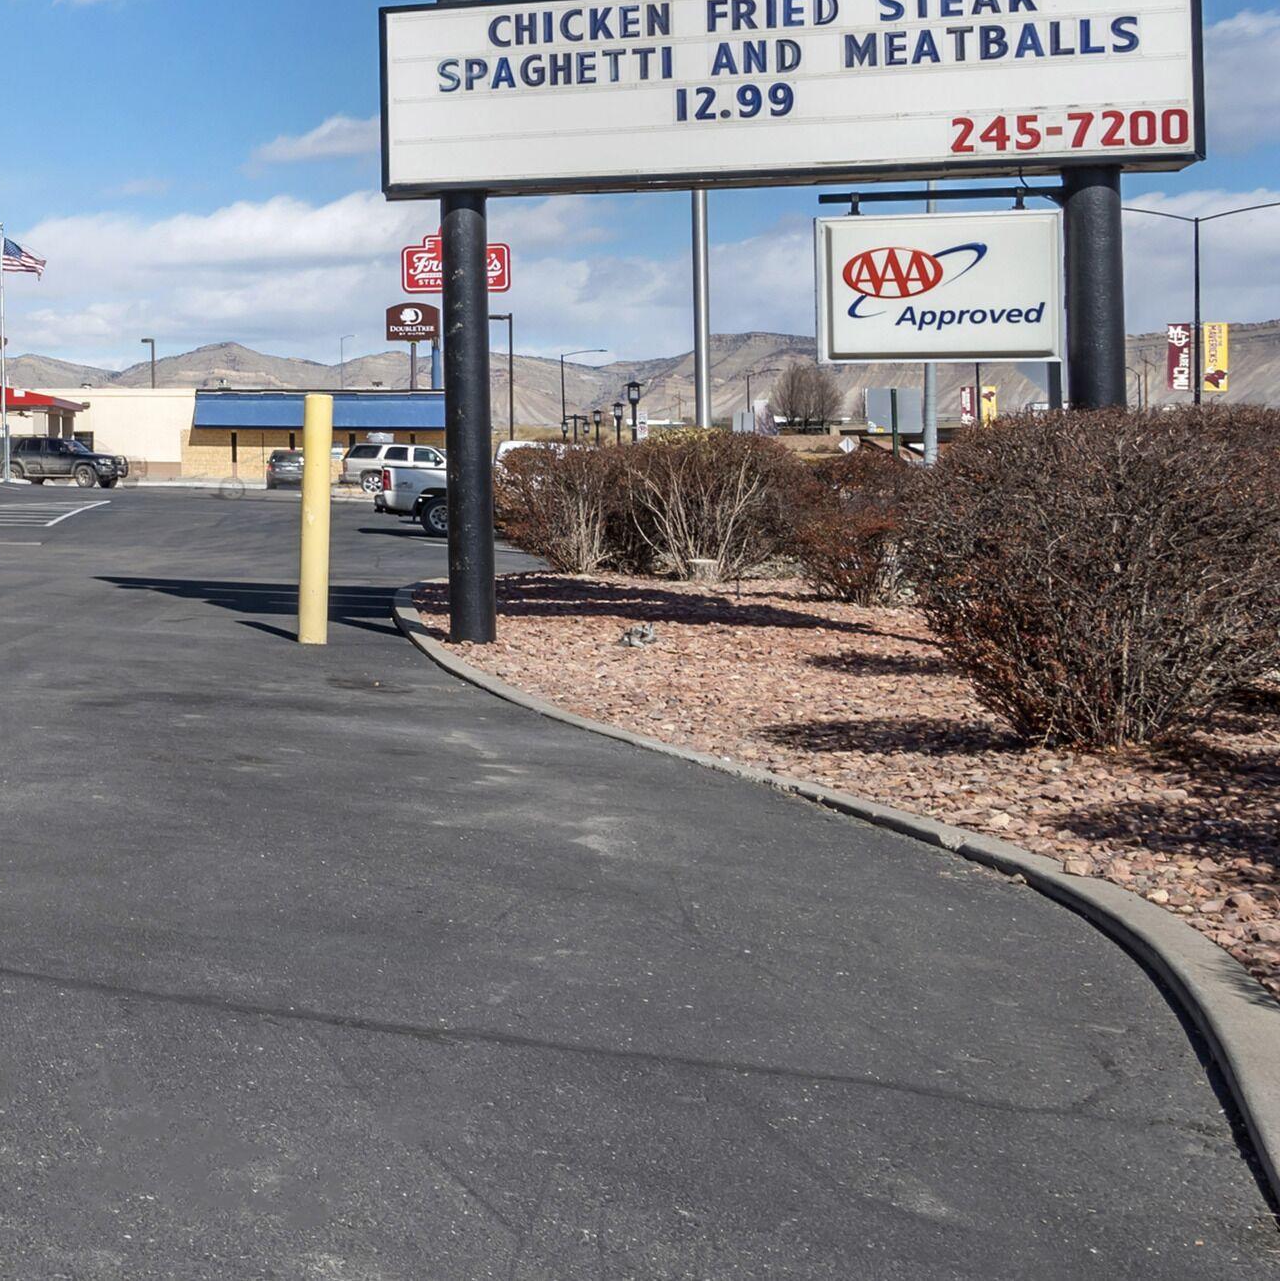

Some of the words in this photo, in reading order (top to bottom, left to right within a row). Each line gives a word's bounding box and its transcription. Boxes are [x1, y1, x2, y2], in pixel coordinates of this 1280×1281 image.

[488, 2, 670, 48] CHICKEN
[437, 46, 673, 92] SPAGHETTI
[711, 39, 802, 76] AND
[844, 16, 1140, 68] MEATBALLS
[676, 82, 794, 122] 12.99
[951, 108, 1189, 152] 245-7200
[850, 248, 935, 298] AAA
[895, 302, 1046, 331] Approved
[1173, 367, 1189, 390] CMU
